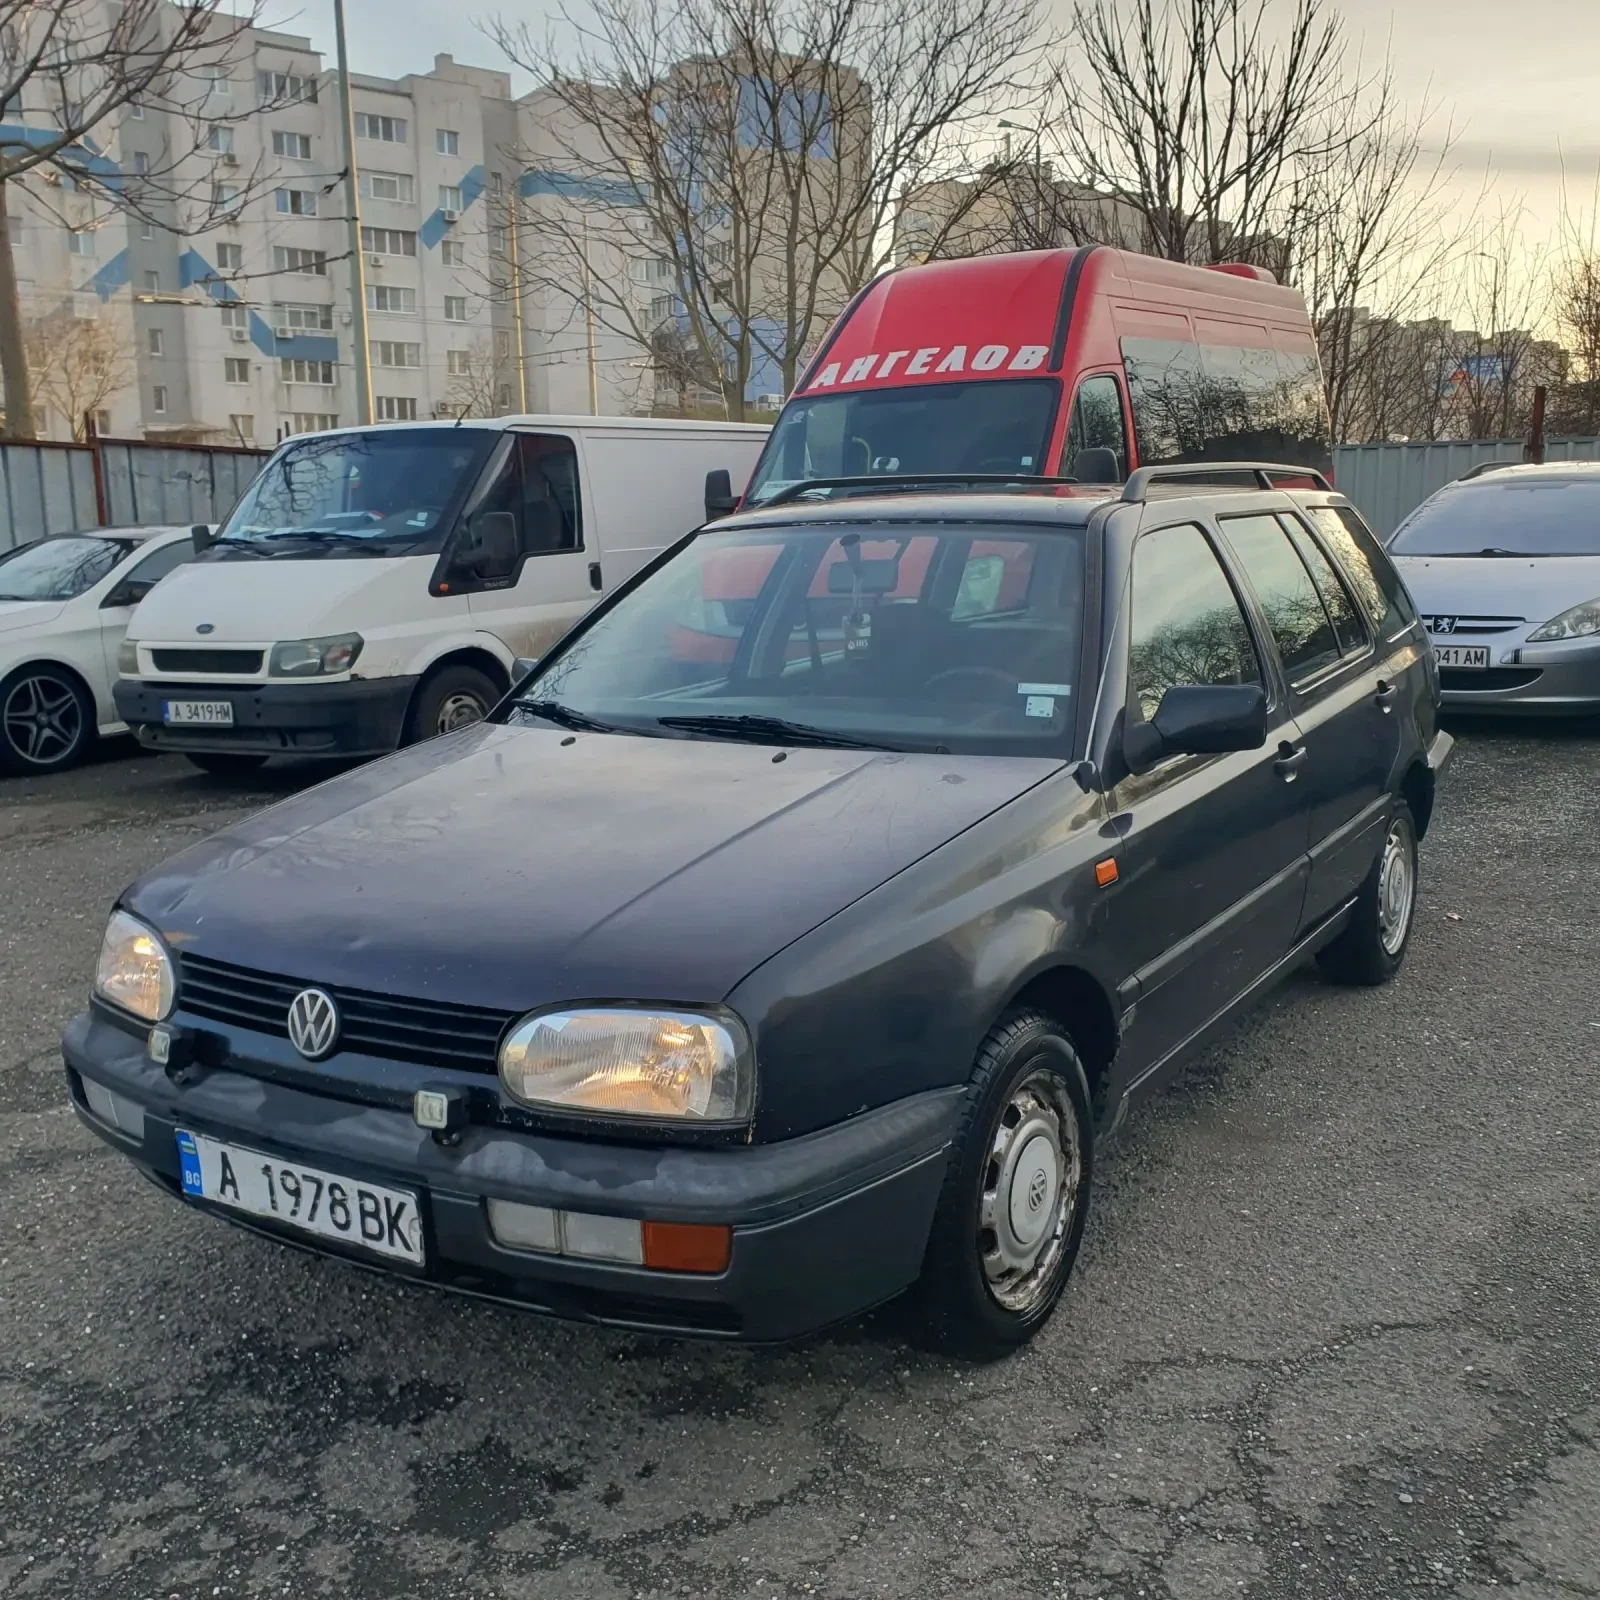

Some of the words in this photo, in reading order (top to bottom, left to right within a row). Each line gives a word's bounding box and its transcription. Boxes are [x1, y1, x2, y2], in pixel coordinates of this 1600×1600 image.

[808, 345, 1050, 390] АНГЕЛОВ
[1463, 650, 1484, 665] AM
[185, 1170, 201, 1186] BG
[220, 1151, 240, 1201] A
